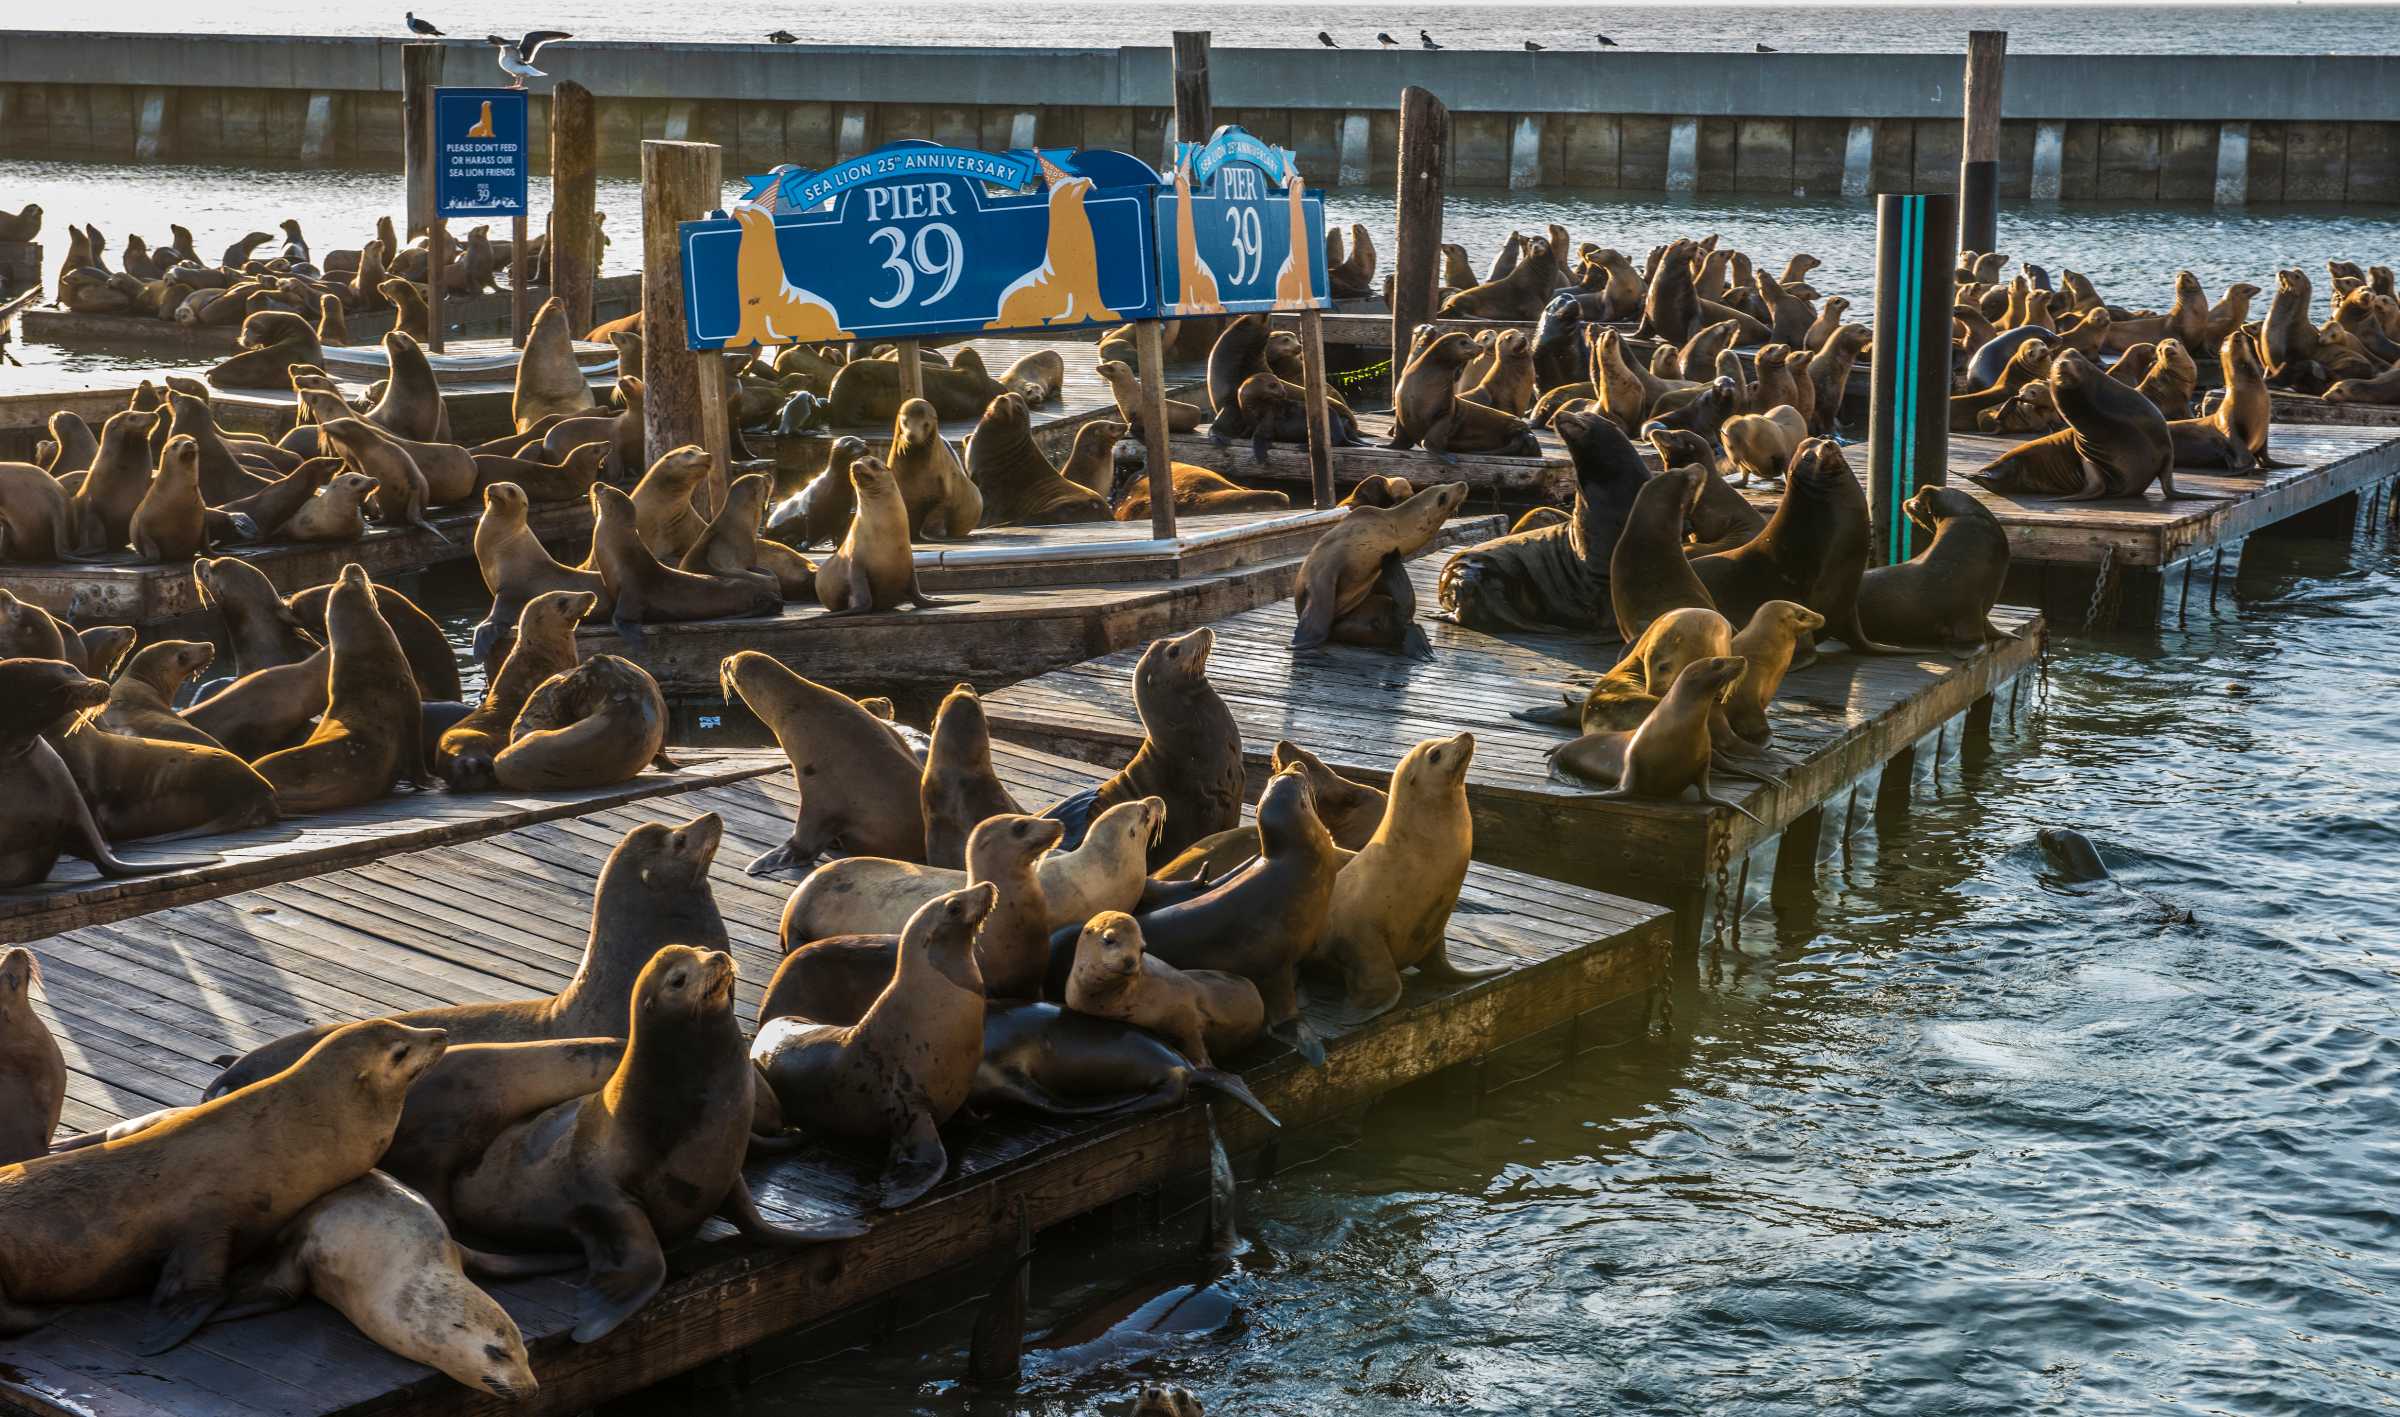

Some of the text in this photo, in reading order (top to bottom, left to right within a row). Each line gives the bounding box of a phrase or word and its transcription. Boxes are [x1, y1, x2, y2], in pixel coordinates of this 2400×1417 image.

[446, 144, 518, 152] PLEASE DON'T FEED
[452, 156, 513, 164] OR HARASS OUR
[449, 168, 516, 176] SEA LION FRIENDS
[804, 179, 833, 201] SEA
[835, 163, 872, 186] LION
[905, 154, 1016, 181] ANNIVERSARY
[1222, 167, 1258, 201] PIER
[477, 189, 490, 201] 39
[864, 182, 958, 222] PIER
[1225, 206, 1263, 286] 39
[868, 222, 964, 309] 39
